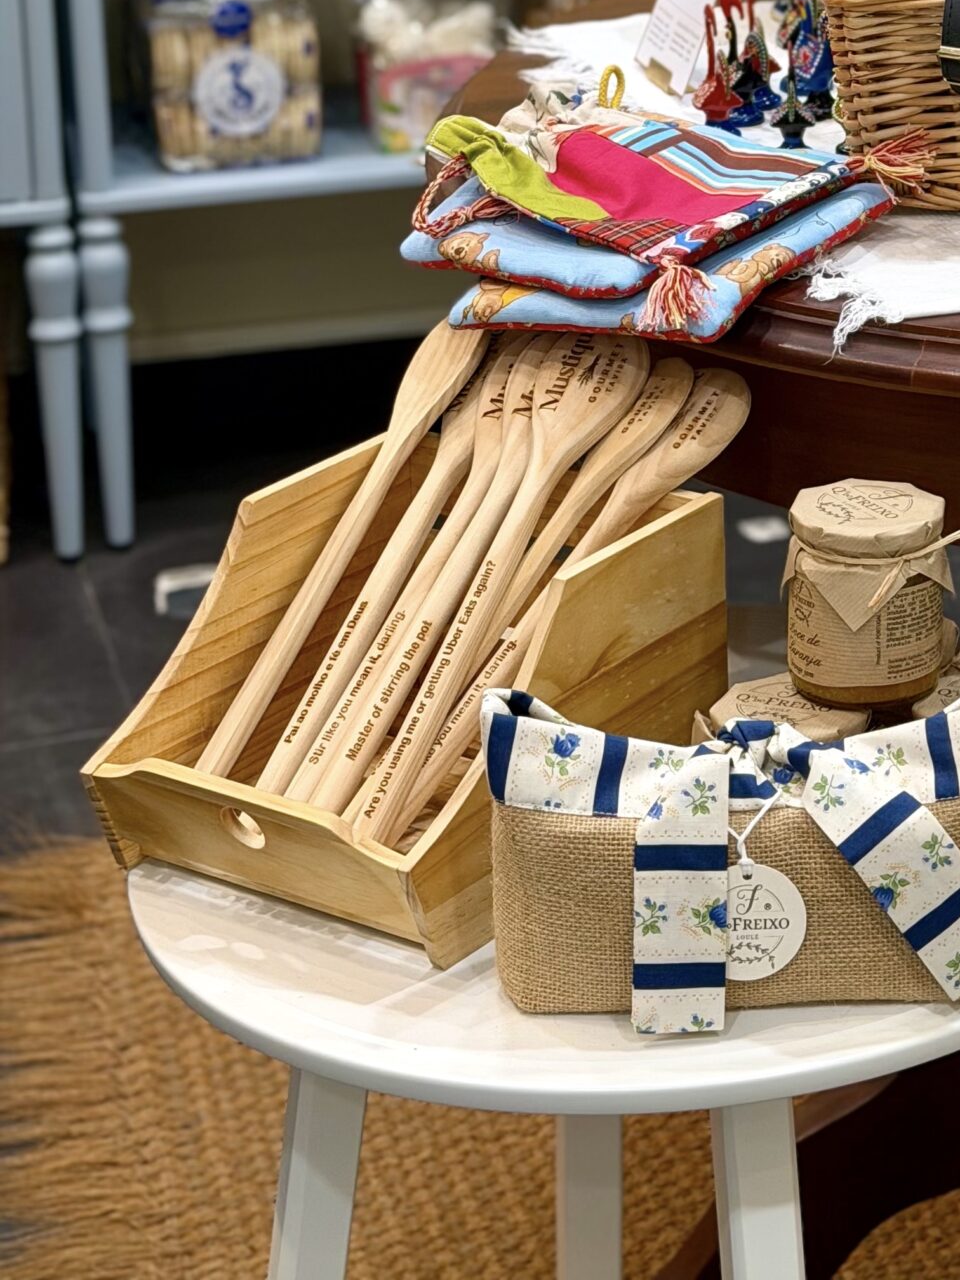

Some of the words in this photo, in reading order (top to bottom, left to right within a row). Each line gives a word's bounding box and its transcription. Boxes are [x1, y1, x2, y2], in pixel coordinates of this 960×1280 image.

[539, 332, 595, 412] Mustiqu
[588, 343, 624, 403] GOURMET
[605, 357, 628, 393] TAVIRA
[672, 390, 720, 450] GOURMET
[284, 729, 298, 744] Pai
[298, 708, 309, 727] ao
[306, 672, 328, 708] molho
[338, 629, 352, 648] em
[347, 600, 369, 630] Deus
[806, 633, 820, 647] de
[309, 741, 327, 765] Stir
[324, 722, 340, 744] like
[338, 698, 353, 721] you
[350, 664, 373, 697] mean
[377, 609, 406, 651] darling.
[345, 719, 375, 761] Master
[371, 702, 385, 719] of
[380, 663, 411, 704] stirring
[403, 639, 420, 663] the
[416, 620, 433, 646] pot
[364, 796, 381, 819] Are
[375, 773, 393, 802] you
[390, 734, 413, 772] using
[406, 714, 421, 739] me
[416, 698, 429, 716] or
[423, 657, 451, 700] getting
[442, 628, 464, 656] Uber
[457, 599, 478, 627] Eats
[473, 560, 497, 599] again?
[434, 726, 452, 748] you
[450, 693, 476, 725] mean
[484, 639, 518, 680] darling.
[732, 917, 790, 932] FREIXO
